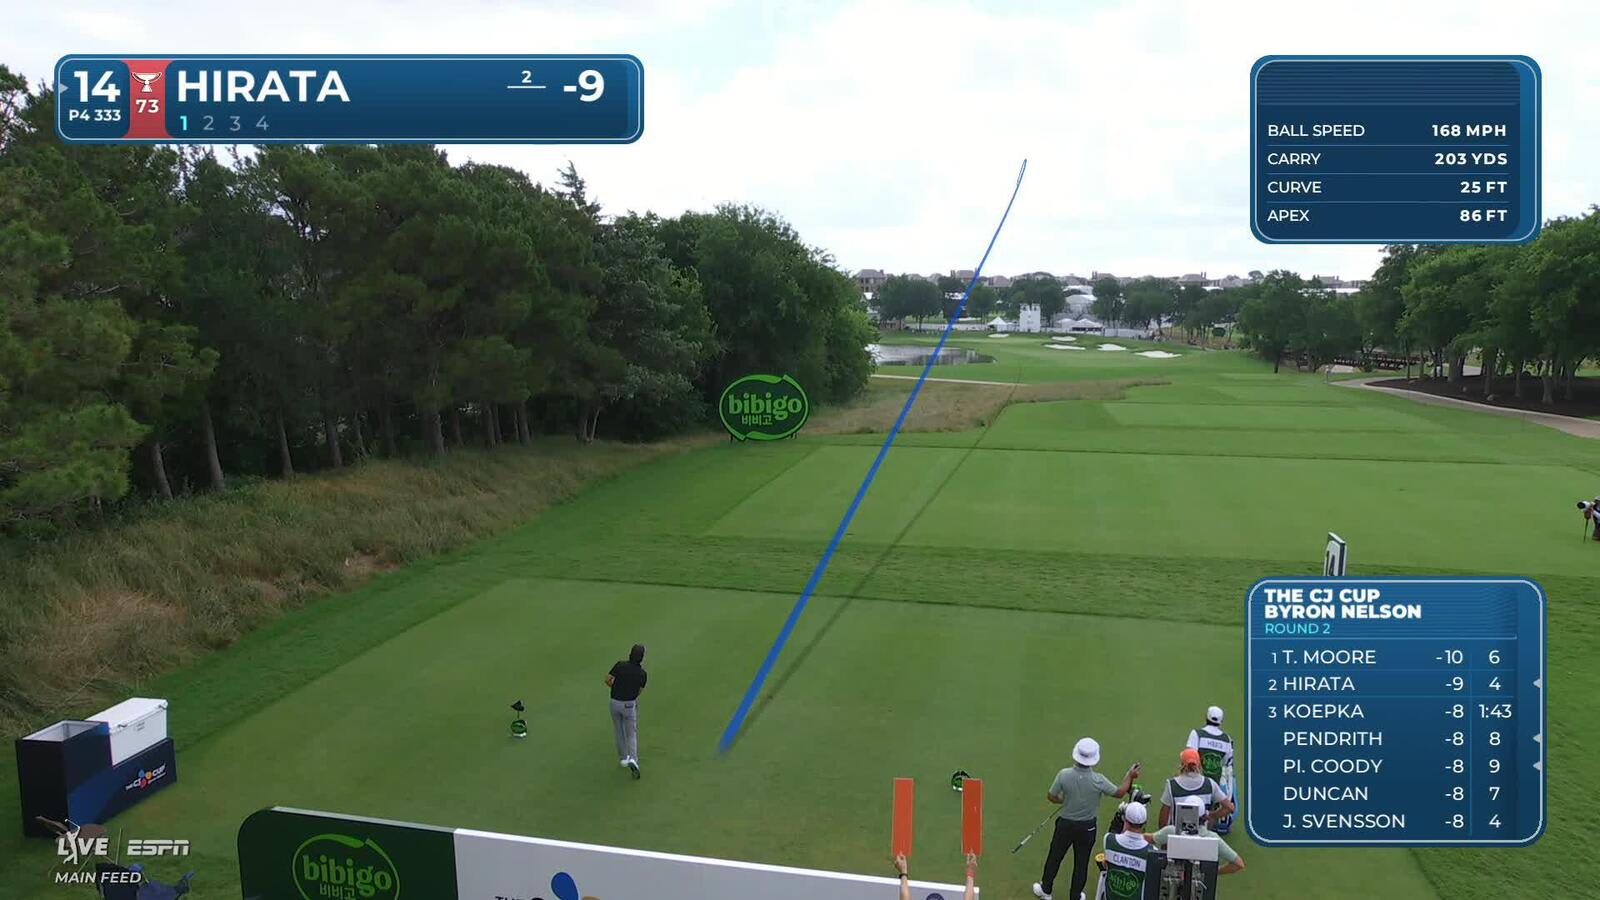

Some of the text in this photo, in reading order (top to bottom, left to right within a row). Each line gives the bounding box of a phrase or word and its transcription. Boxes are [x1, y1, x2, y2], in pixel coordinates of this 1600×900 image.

[728, 392, 803, 421] bibigo
[741, 415, 773, 426] 비비고
[303, 854, 392, 898] bibigo
